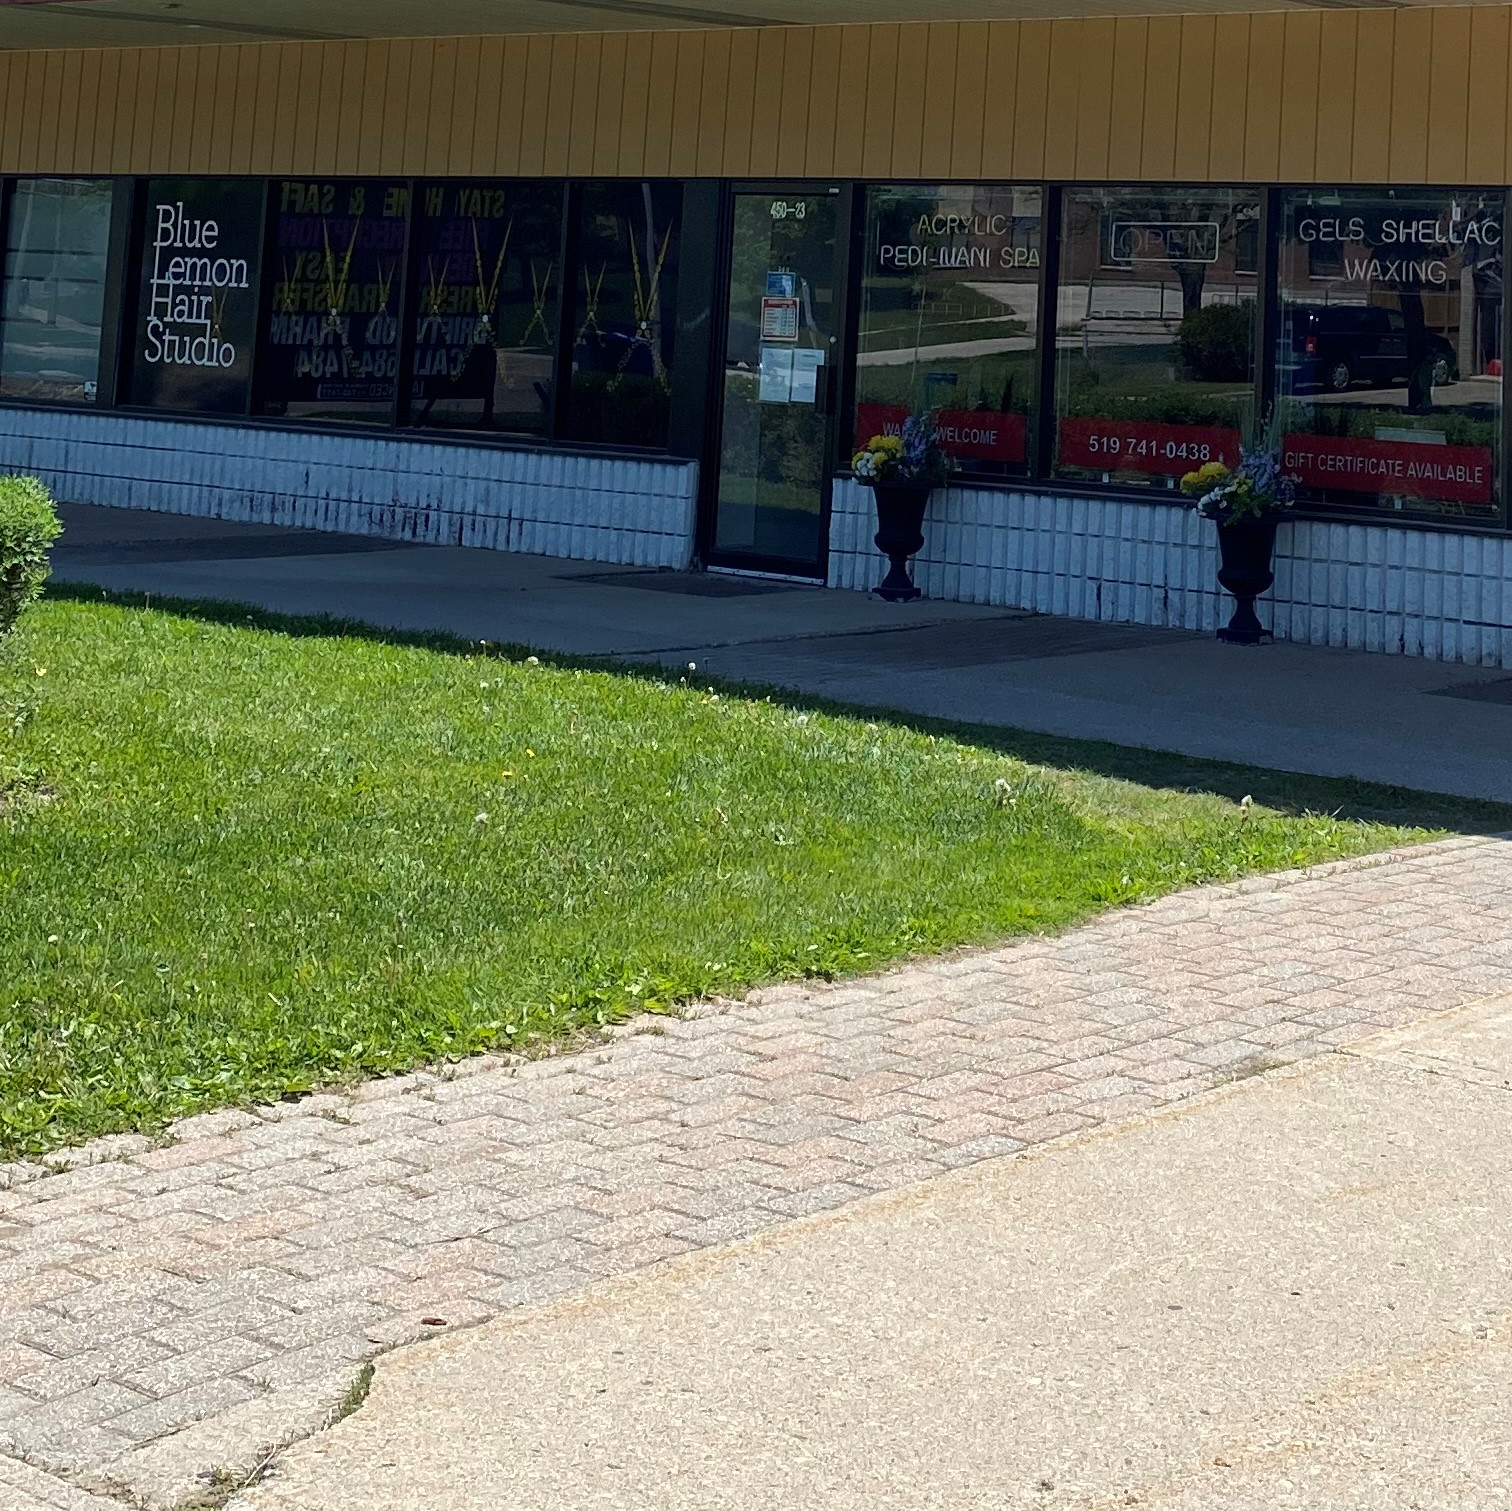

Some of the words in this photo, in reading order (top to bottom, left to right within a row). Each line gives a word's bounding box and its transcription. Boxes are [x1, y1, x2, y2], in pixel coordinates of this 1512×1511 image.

[770, 201, 806, 219] 450-23
[152, 201, 219, 248] Blue
[917, 214, 1007, 236] ACRYLIC
[1300, 217, 1365, 242] GELS
[1381, 218, 1501, 245] SHELLAC
[1119, 226, 1209, 256] OPEN
[150, 245, 249, 289] Lemon
[880, 244, 991, 268] PEDI-MANI
[1000, 246, 1040, 268] SPA
[1344, 258, 1448, 284] WAXING
[147, 280, 212, 324] Hair
[144, 318, 236, 368] Studio
[934, 426, 998, 446] WELCOME
[1088, 435, 1120, 455] 519
[1126, 437, 1211, 462] 741-0438
[1285, 451, 1314, 469] GIFT
[1317, 454, 1404, 477] CERTIFICATE
[1406, 461, 1483, 484] AVAILABLE
